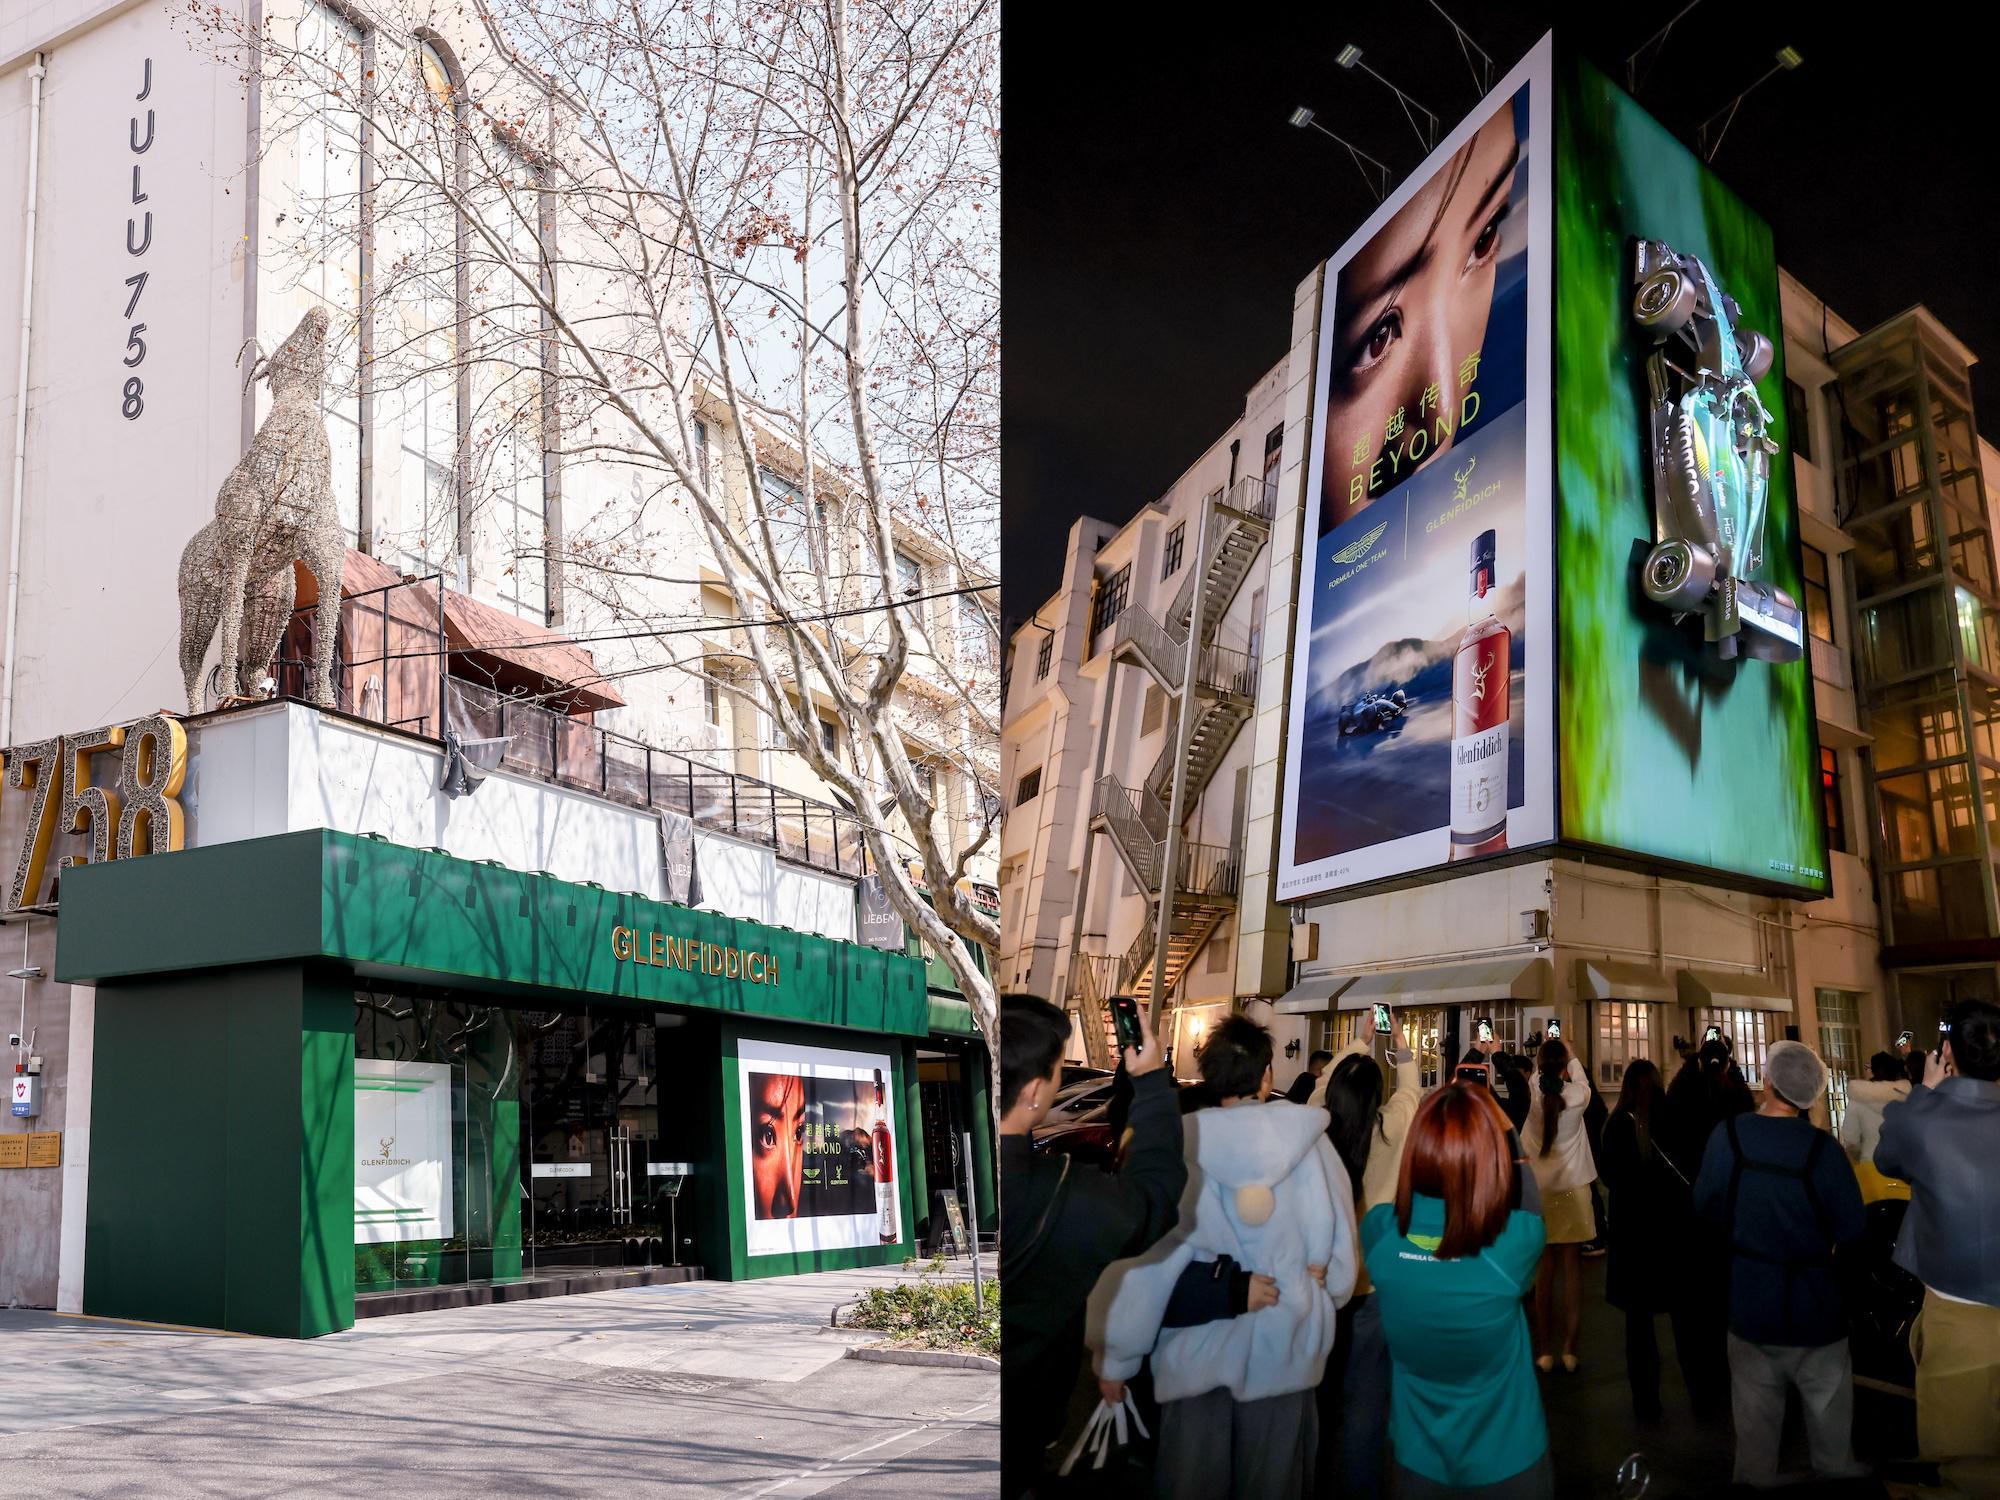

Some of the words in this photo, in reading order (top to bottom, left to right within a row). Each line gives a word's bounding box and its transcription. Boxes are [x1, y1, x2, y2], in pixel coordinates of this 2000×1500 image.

[1352, 350, 1482, 470] 超越传奇
[1349, 391, 1481, 505] BEYOND
[1425, 480, 1501, 533] GLENFIDDICH
[1328, 569, 1355, 590] FORMULA
[1370, 548, 1388, 564] TEAM
[1724, 578, 1733, 621] oinbase
[1457, 732, 1502, 765] Glenfiddich
[8, 716, 188, 912] 758
[1466, 777, 1490, 814] 15
[863, 912, 895, 925] LIEBEN
[611, 925, 780, 987] GLENFIDDICH
[806, 1142, 841, 1154] BEYOND
